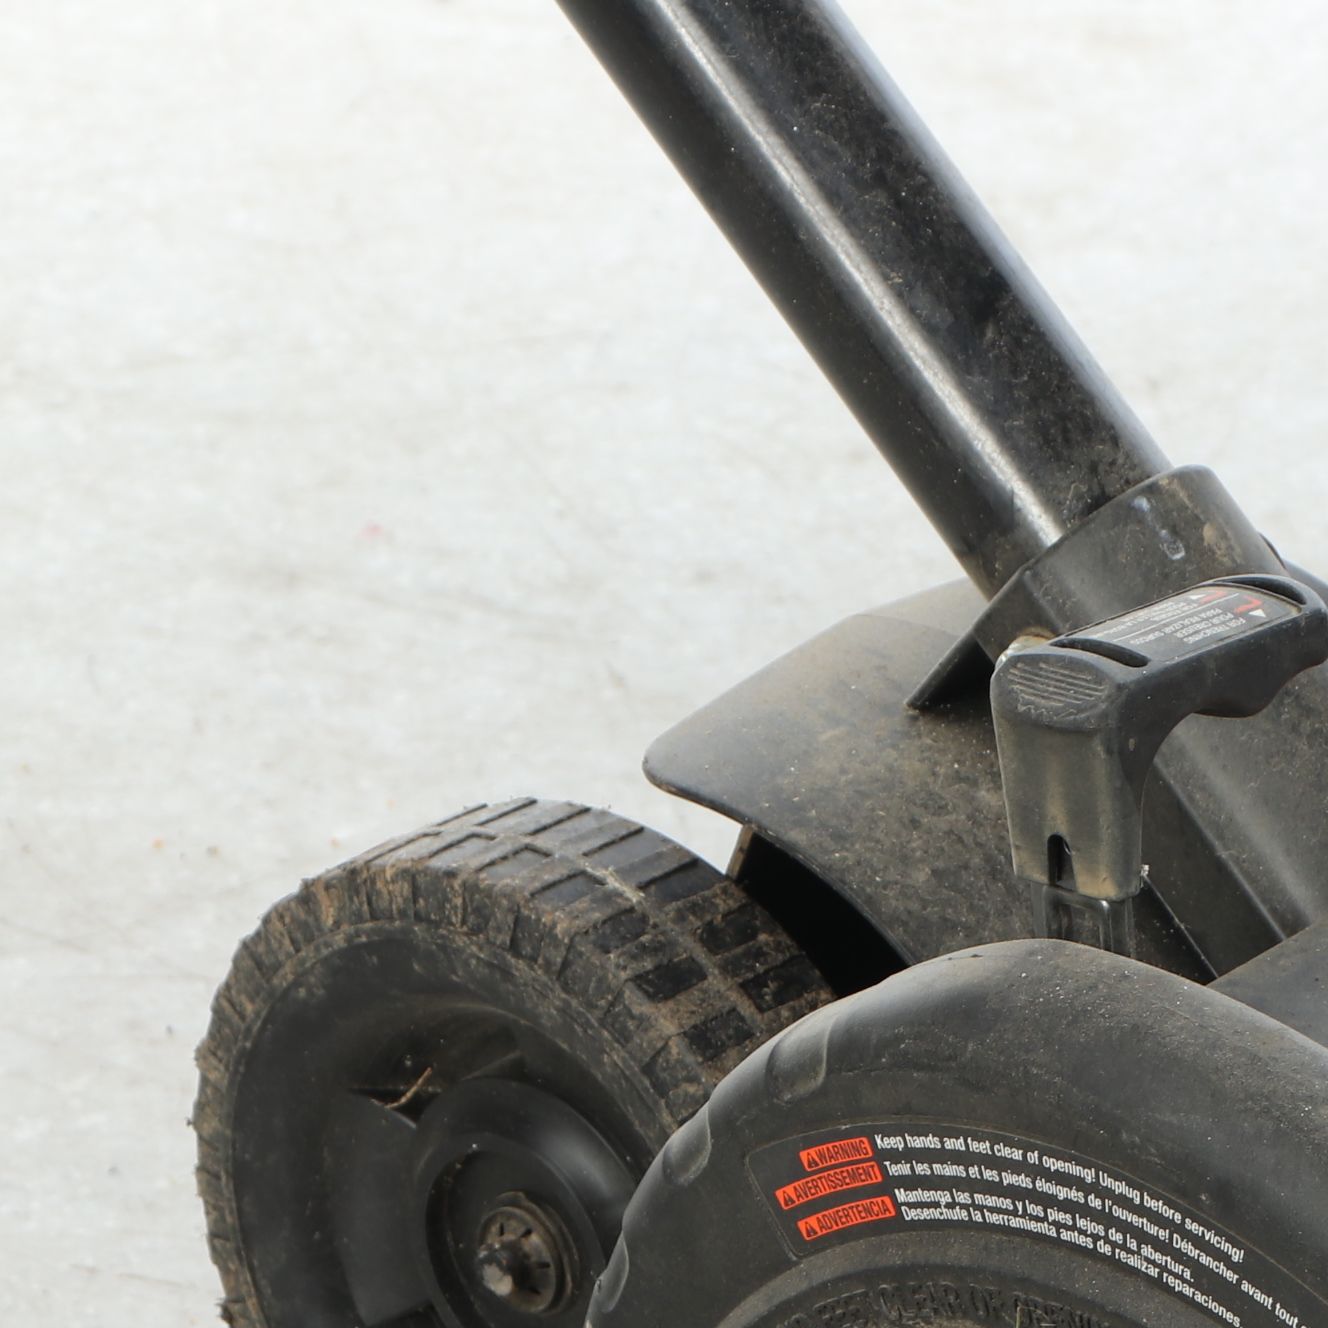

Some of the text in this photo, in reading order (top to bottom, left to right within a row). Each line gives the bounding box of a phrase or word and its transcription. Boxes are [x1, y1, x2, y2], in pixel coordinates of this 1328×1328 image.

[793, 1164, 880, 1201] AVERTISSEMENT
[884, 1160, 911, 1177] Tenir
[913, 1160, 931, 1175] les
[932, 1162, 966, 1177] mains
[968, 1165, 981, 1180] et
[982, 1165, 999, 1182] les
[1001, 1170, 1033, 1191] pieds
[1035, 1175, 1085, 1204] éloignés
[1087, 1193, 1103, 1211] de
[1105, 1199, 1170, 1243] l'ouverture!
[1172, 1234, 1240, 1285] Débrancher
[1240, 1279, 1273, 1311] avant
[815, 1134, 1245, 1264] WARNING Keep hands and feet clear of opening! Unplug before servicing!
[817, 1188, 1195, 1282] ADVERTENCIA Mantenga las manos y los pies lejos de la abertura.
[901, 1205, 969, 1222] Desenchufe
[971, 1208, 983, 1223] la
[985, 1211, 1058, 1238] herramienta
[1059, 1228, 1094, 1249] antes
[1096, 1239, 1113, 1257] de
[1115, 1248, 1159, 1280] realizar
